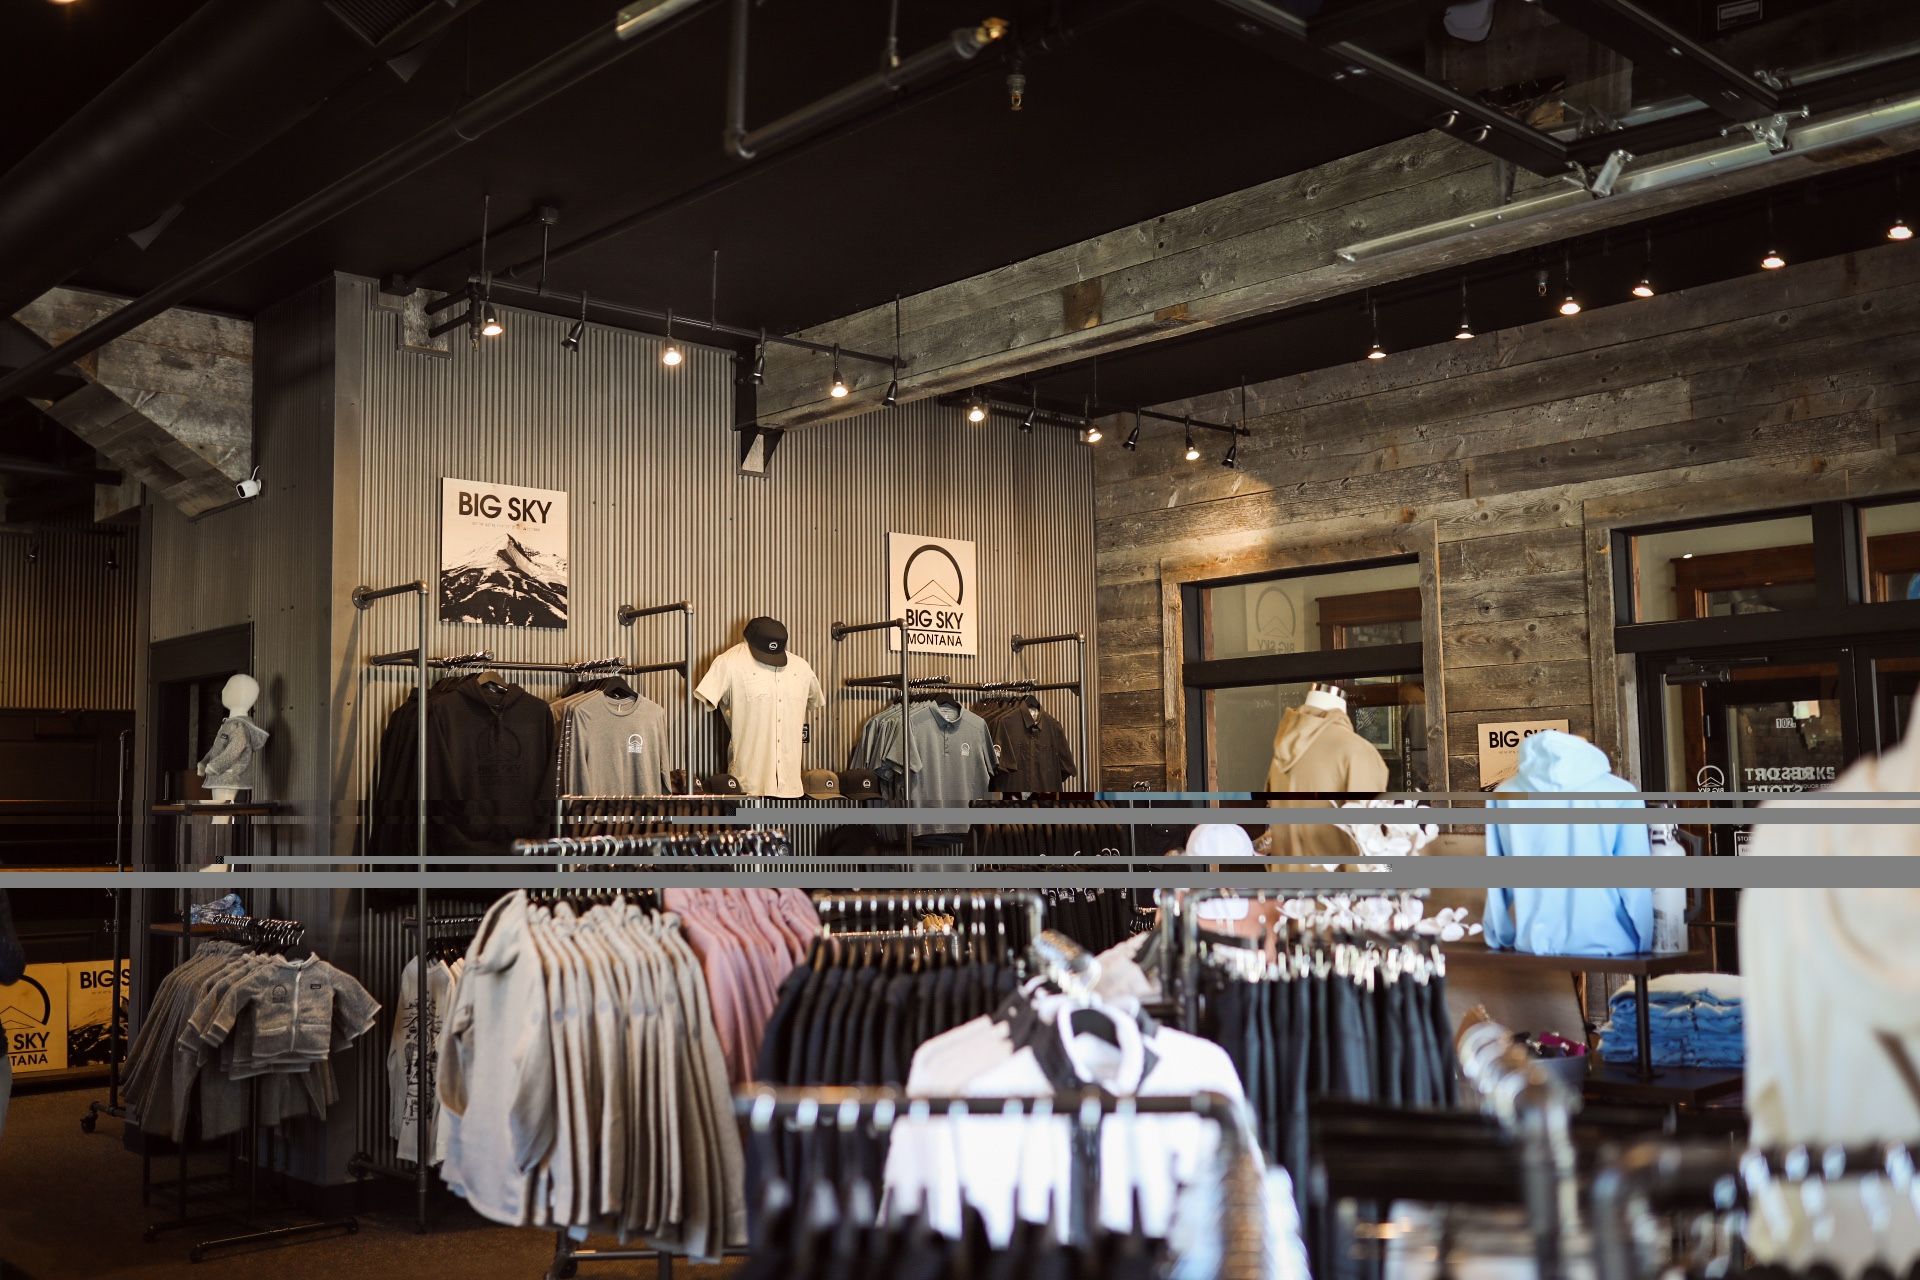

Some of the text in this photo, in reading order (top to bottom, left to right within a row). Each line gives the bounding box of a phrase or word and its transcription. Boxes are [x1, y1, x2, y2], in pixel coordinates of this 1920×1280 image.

[459, 491, 552, 524] BIG SKY
[906, 609, 963, 630] BIG SKY
[907, 632, 962, 647] MONTANA
[1489, 730, 1520, 748] BIG
[80, 969, 114, 989] BIG
[13, 1031, 50, 1051] SKY
[8, 1053, 49, 1067] TANA
